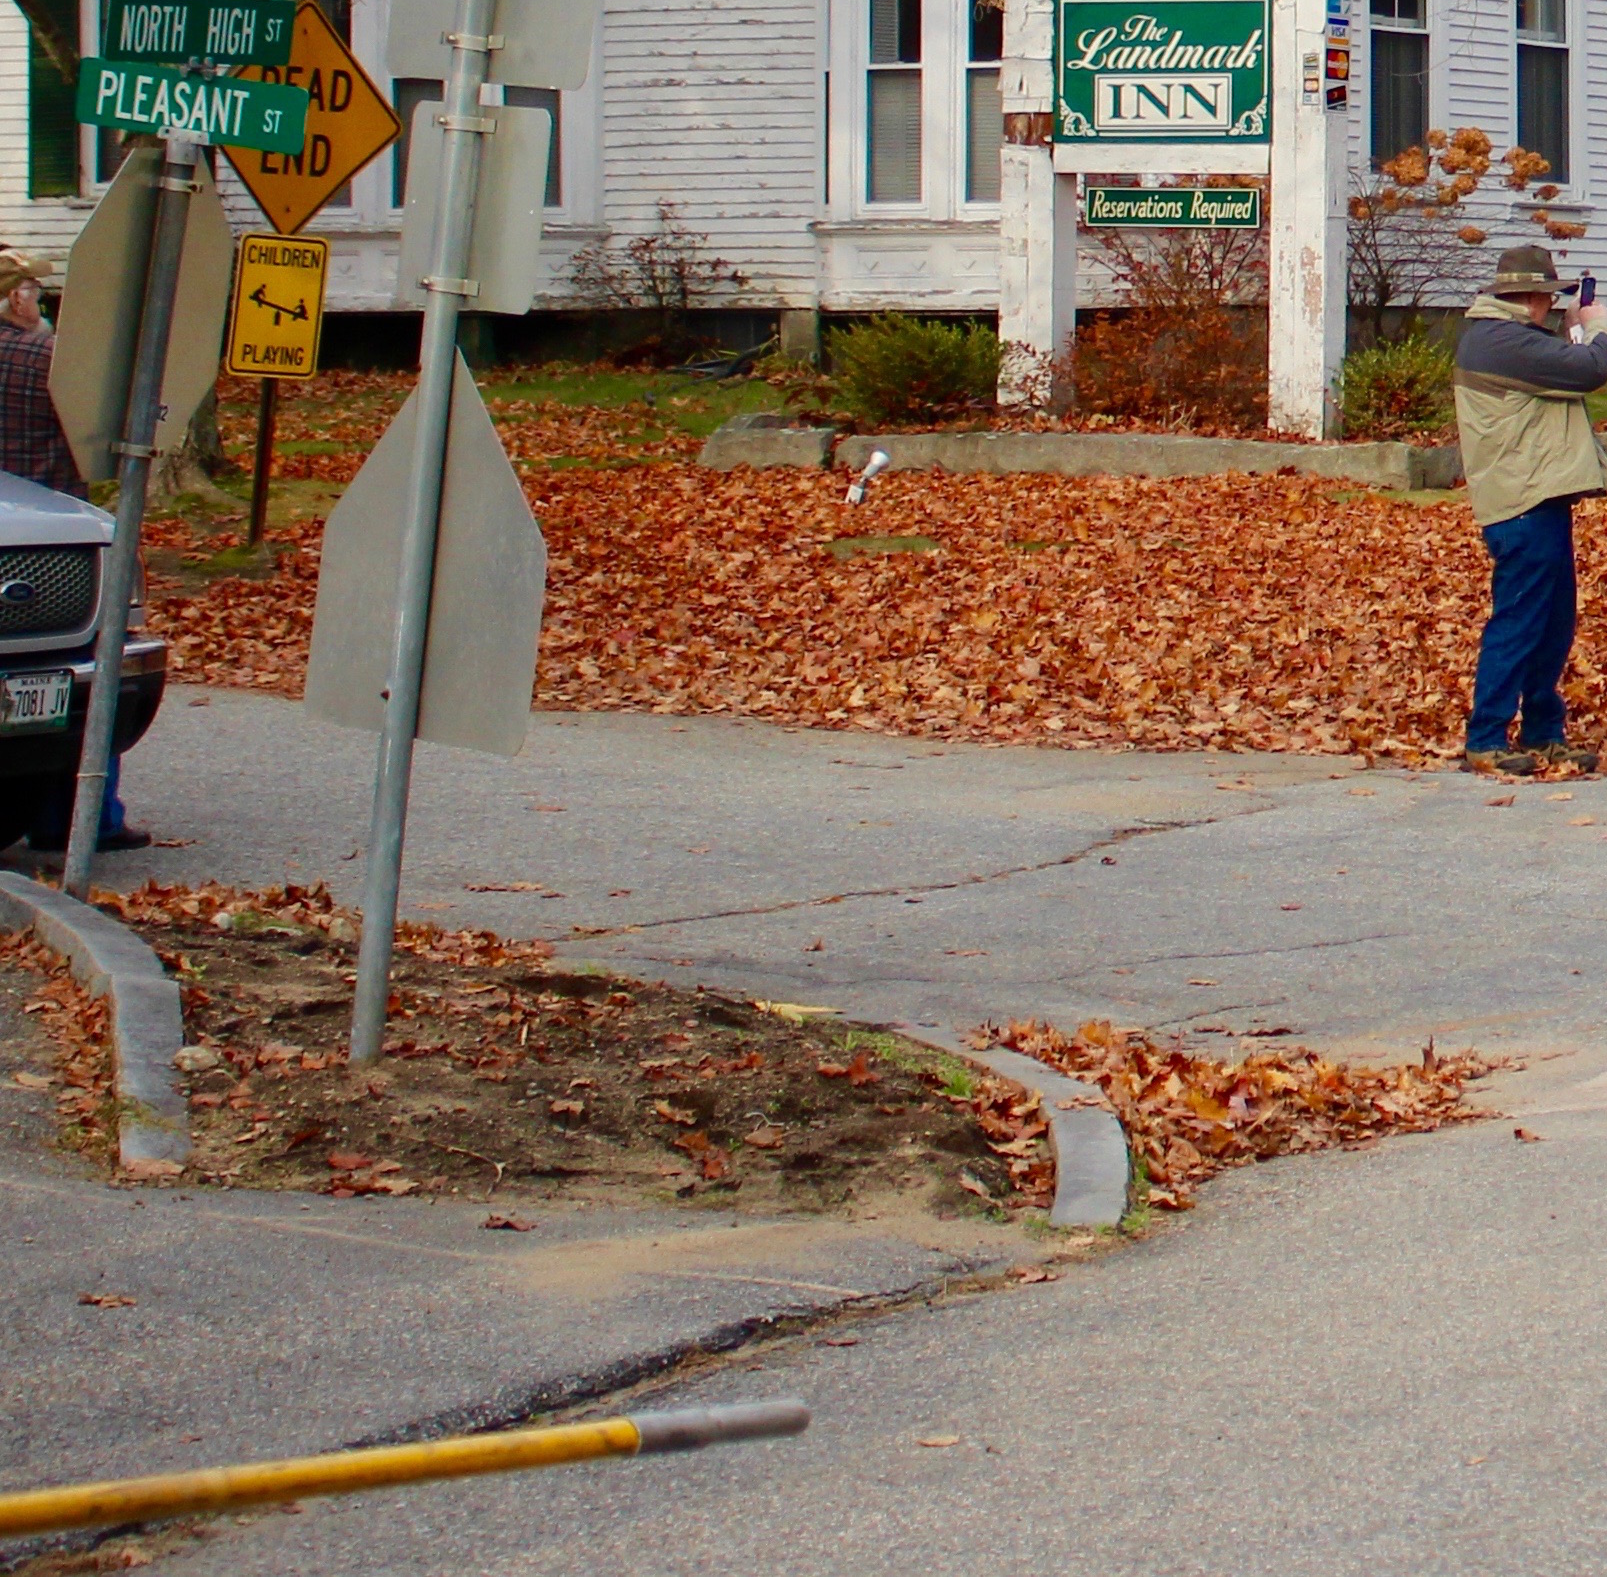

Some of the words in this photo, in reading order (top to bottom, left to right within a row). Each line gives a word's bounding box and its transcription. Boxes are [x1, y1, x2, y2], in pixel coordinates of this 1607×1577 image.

[119, 4, 188, 53] NORTH
[206, 7, 257, 55] HIGH
[265, 18, 283, 42] ST
[1120, 14, 1168, 42] The
[1066, 27, 1262, 71] Landmark
[96, 69, 250, 137] PLEASANT
[262, 108, 283, 134] ST
[1106, 83, 1223, 120] INN
[1091, 191, 1183, 219] Reservations
[1190, 191, 1254, 225] Required
[247, 244, 321, 268] CHILDREN
[241, 343, 305, 366] PLAYING
[15, 689, 45, 717] 7081
